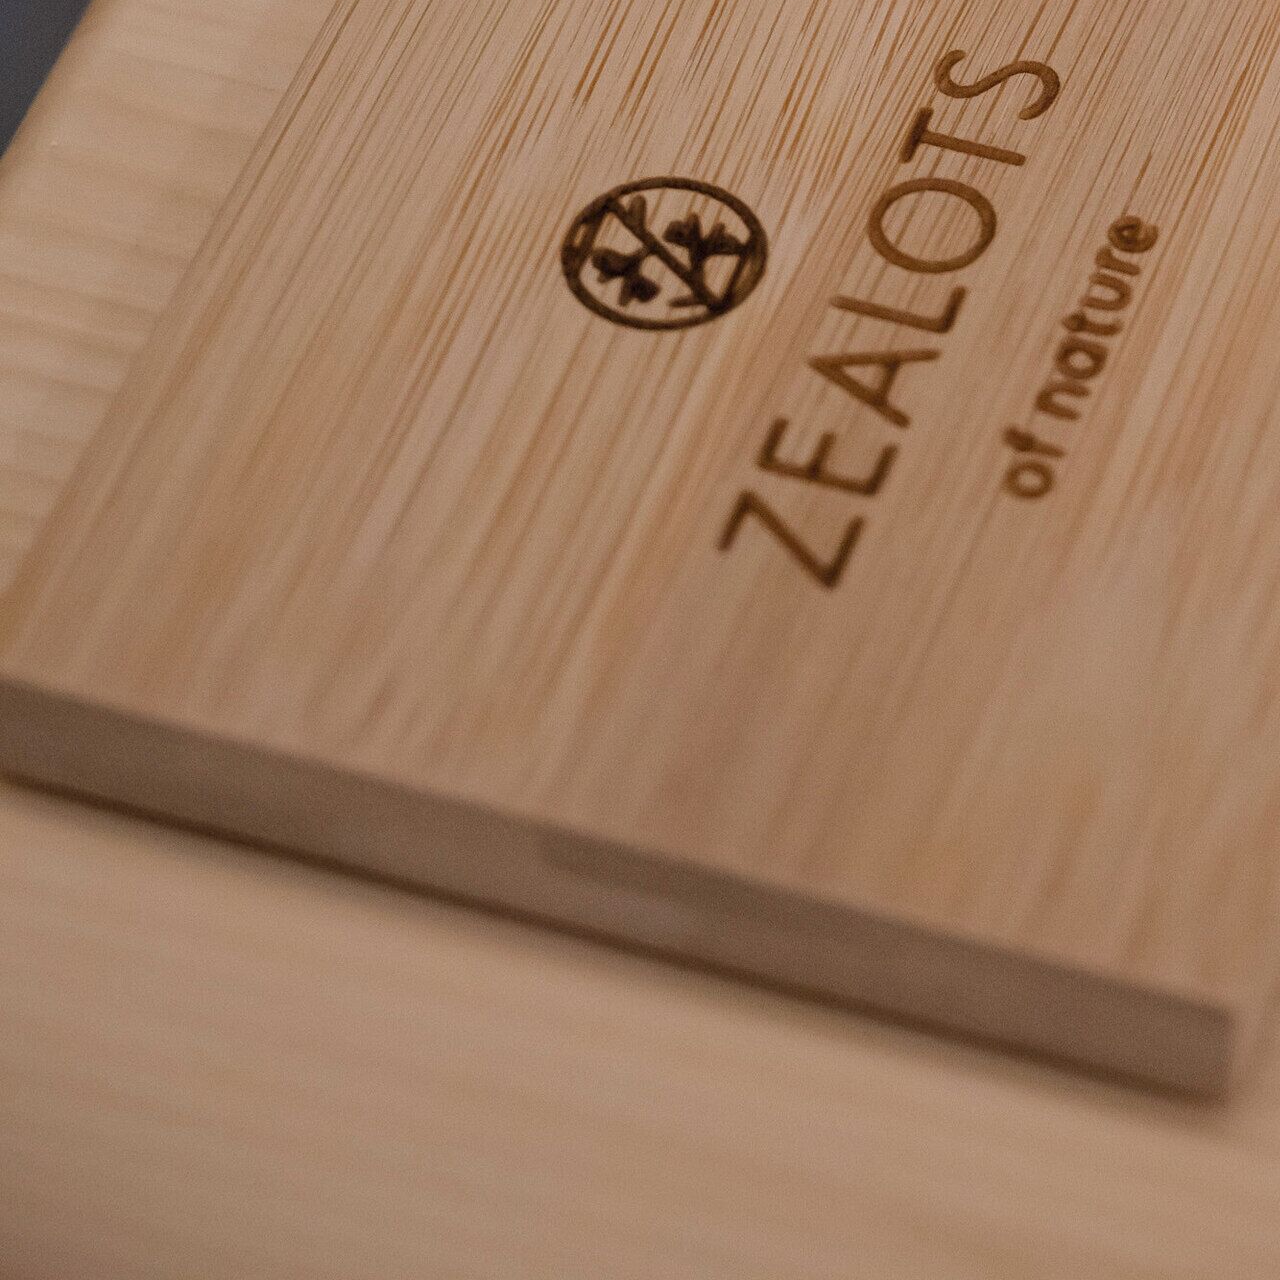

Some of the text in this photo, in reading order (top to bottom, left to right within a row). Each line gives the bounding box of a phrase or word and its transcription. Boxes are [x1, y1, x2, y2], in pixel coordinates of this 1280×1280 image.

[715, 48, 1062, 590] ZEALOTS
[1002, 214, 1160, 501] of nature
